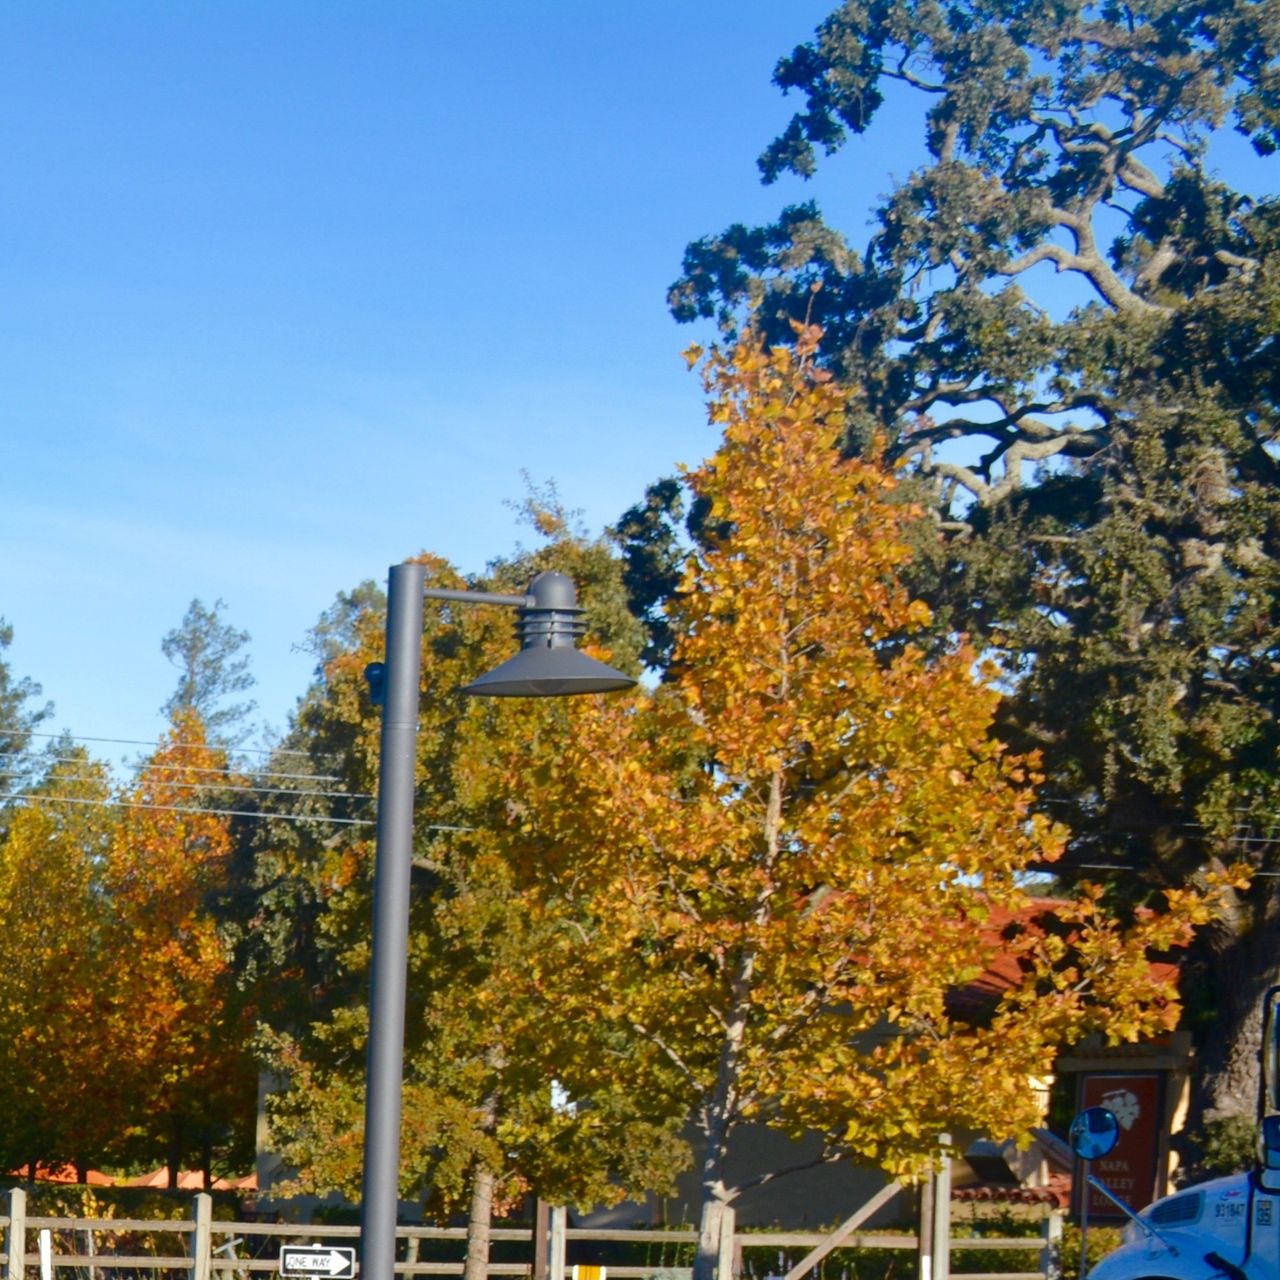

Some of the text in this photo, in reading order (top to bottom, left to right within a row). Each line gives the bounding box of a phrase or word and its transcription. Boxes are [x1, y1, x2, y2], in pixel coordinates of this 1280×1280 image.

[1099, 1160, 1129, 1172] NAPA
[288, 1256, 332, 1268] ONE WAY
